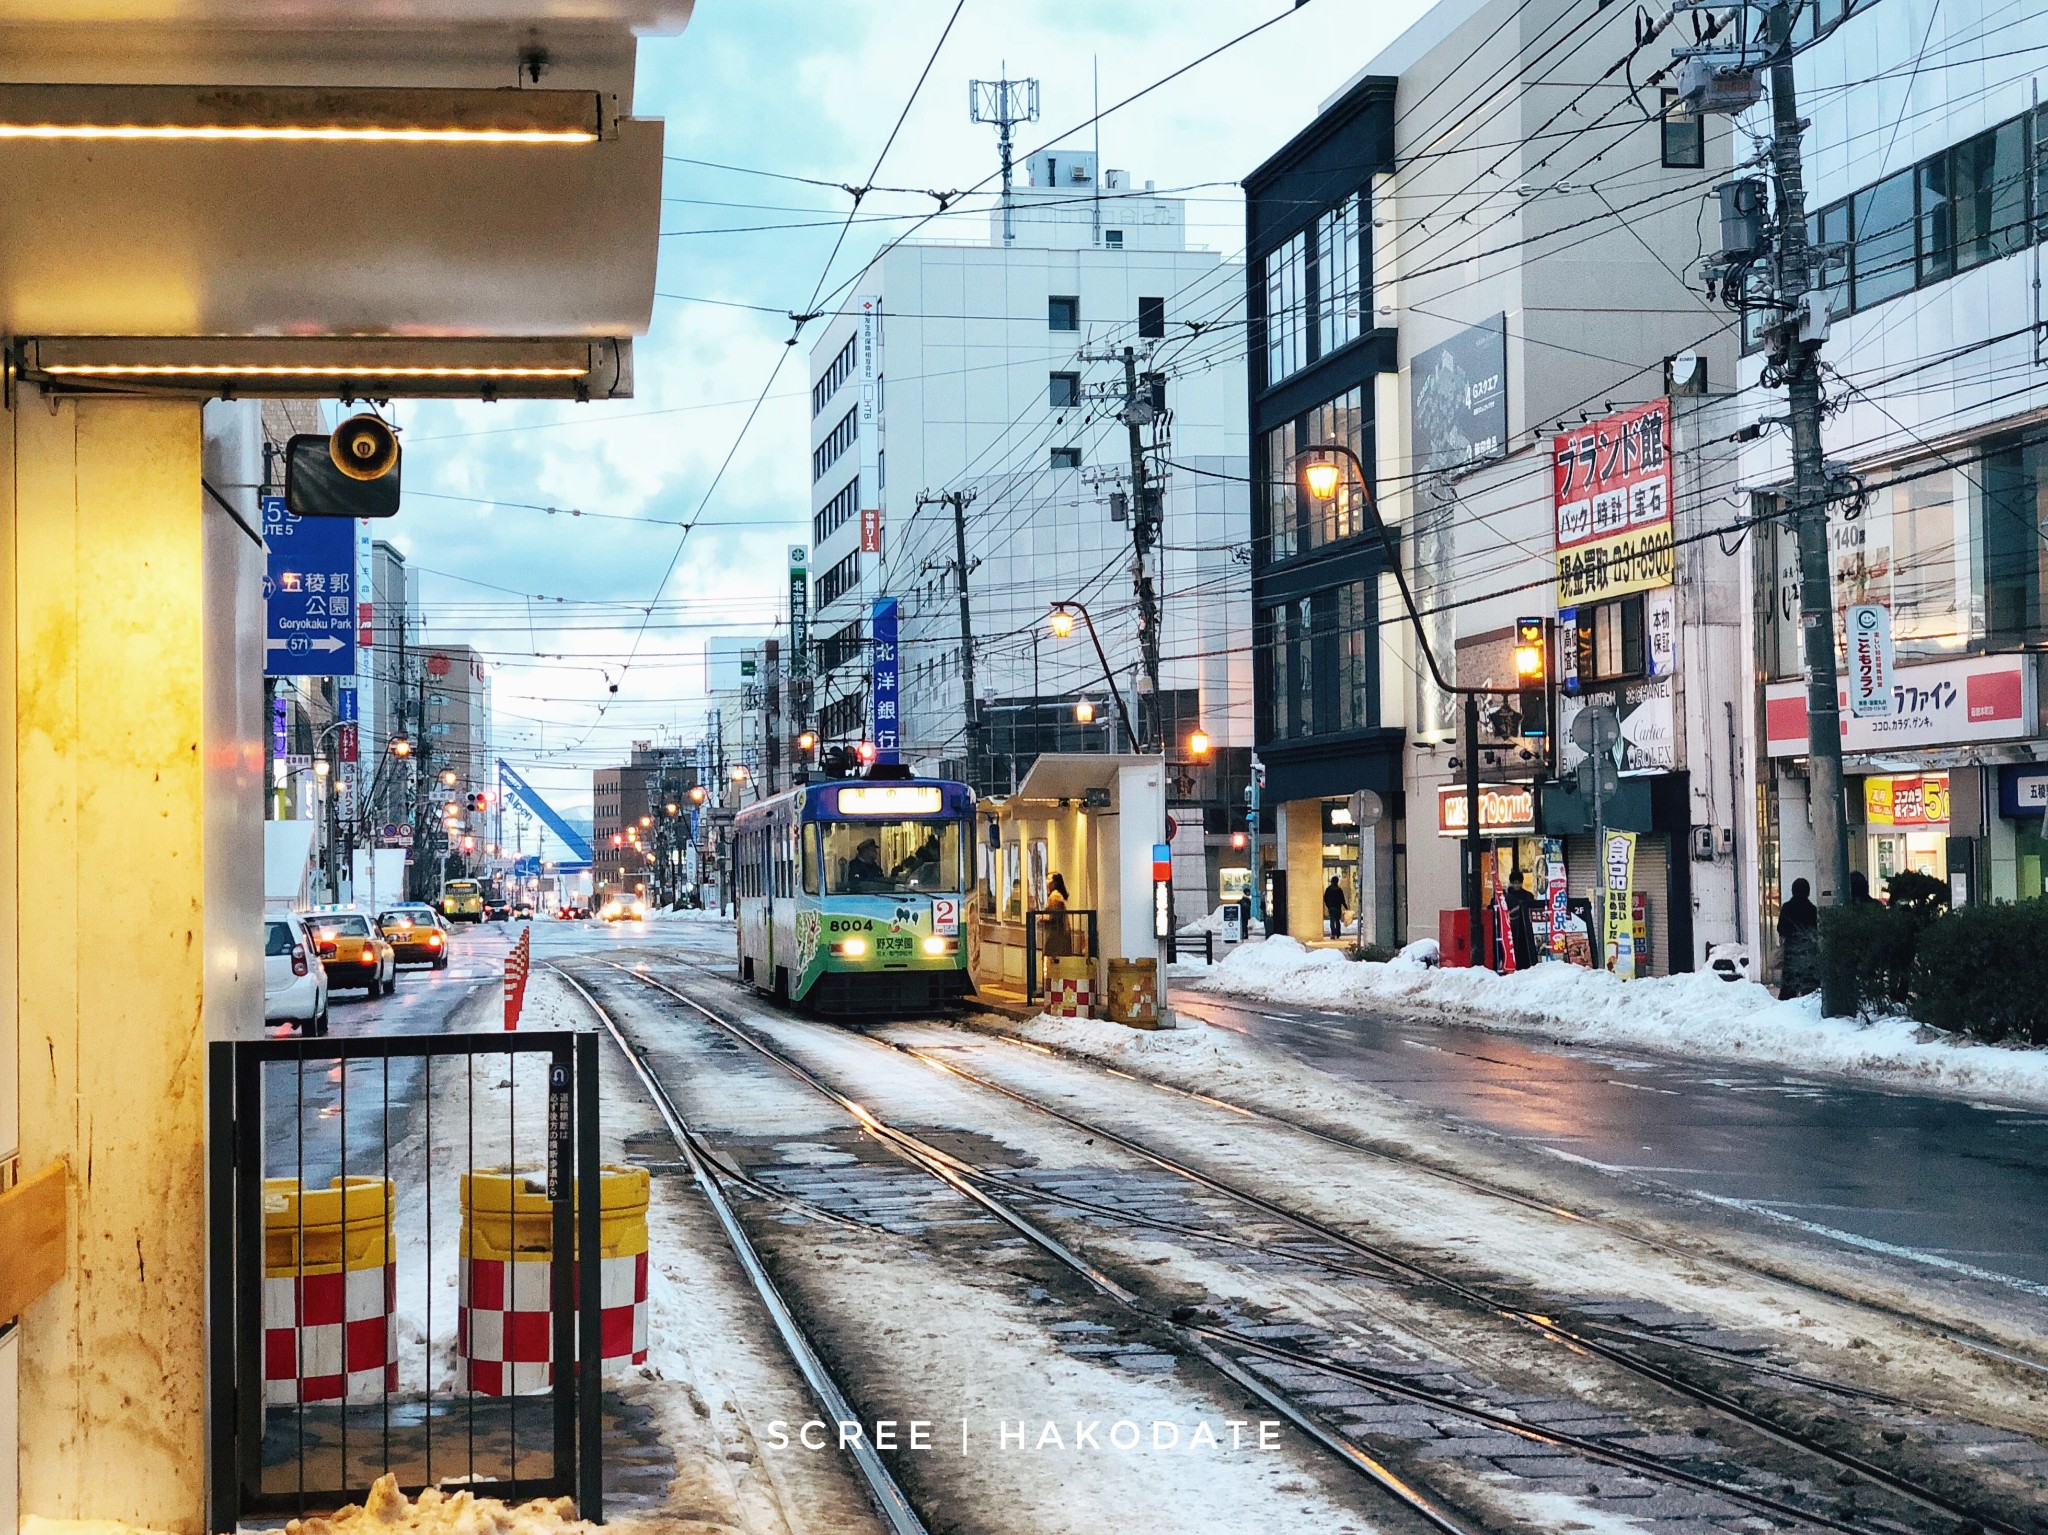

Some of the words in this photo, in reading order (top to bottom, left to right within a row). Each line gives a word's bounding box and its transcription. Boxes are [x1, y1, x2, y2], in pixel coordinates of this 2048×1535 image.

[1557, 410, 1665, 499] ブランド館
[1596, 496, 1622, 528] 時計
[1634, 485, 1661, 519] 宝石
[285, 524, 294, 536] 5
[865, 512, 875, 551] 中道リース
[361, 537, 370, 593] 第一生命
[1559, 547, 1609, 600] 現金買取
[282, 573, 350, 593] 五稜郭
[305, 595, 349, 616] 公園
[279, 617, 328, 630] Goryokaku
[330, 617, 352, 630] Park
[1652, 609, 1670, 633] 本物
[291, 638, 308, 650] 571
[1653, 632, 1670, 654] 保証
[1858, 632, 1874, 698] こどもクラブ
[876, 642, 897, 749] 北洋銀行
[1635, 683, 1670, 704] CHANEL
[1633, 719, 1667, 742] Cartier
[1636, 746, 1672, 768] ROLEX
[503, 791, 533, 822] Alpen
[1895, 788, 1922, 804] ココカラ
[1894, 803, 1923, 818] ポイント
[1606, 836, 1632, 890] 食品
[936, 901, 954, 924] 2
[1574, 906, 1584, 915] 2F
[829, 919, 874, 932] 8004
[876, 937, 913, 950] 野又学園
[559, 1093, 569, 1140] 道路横断は
